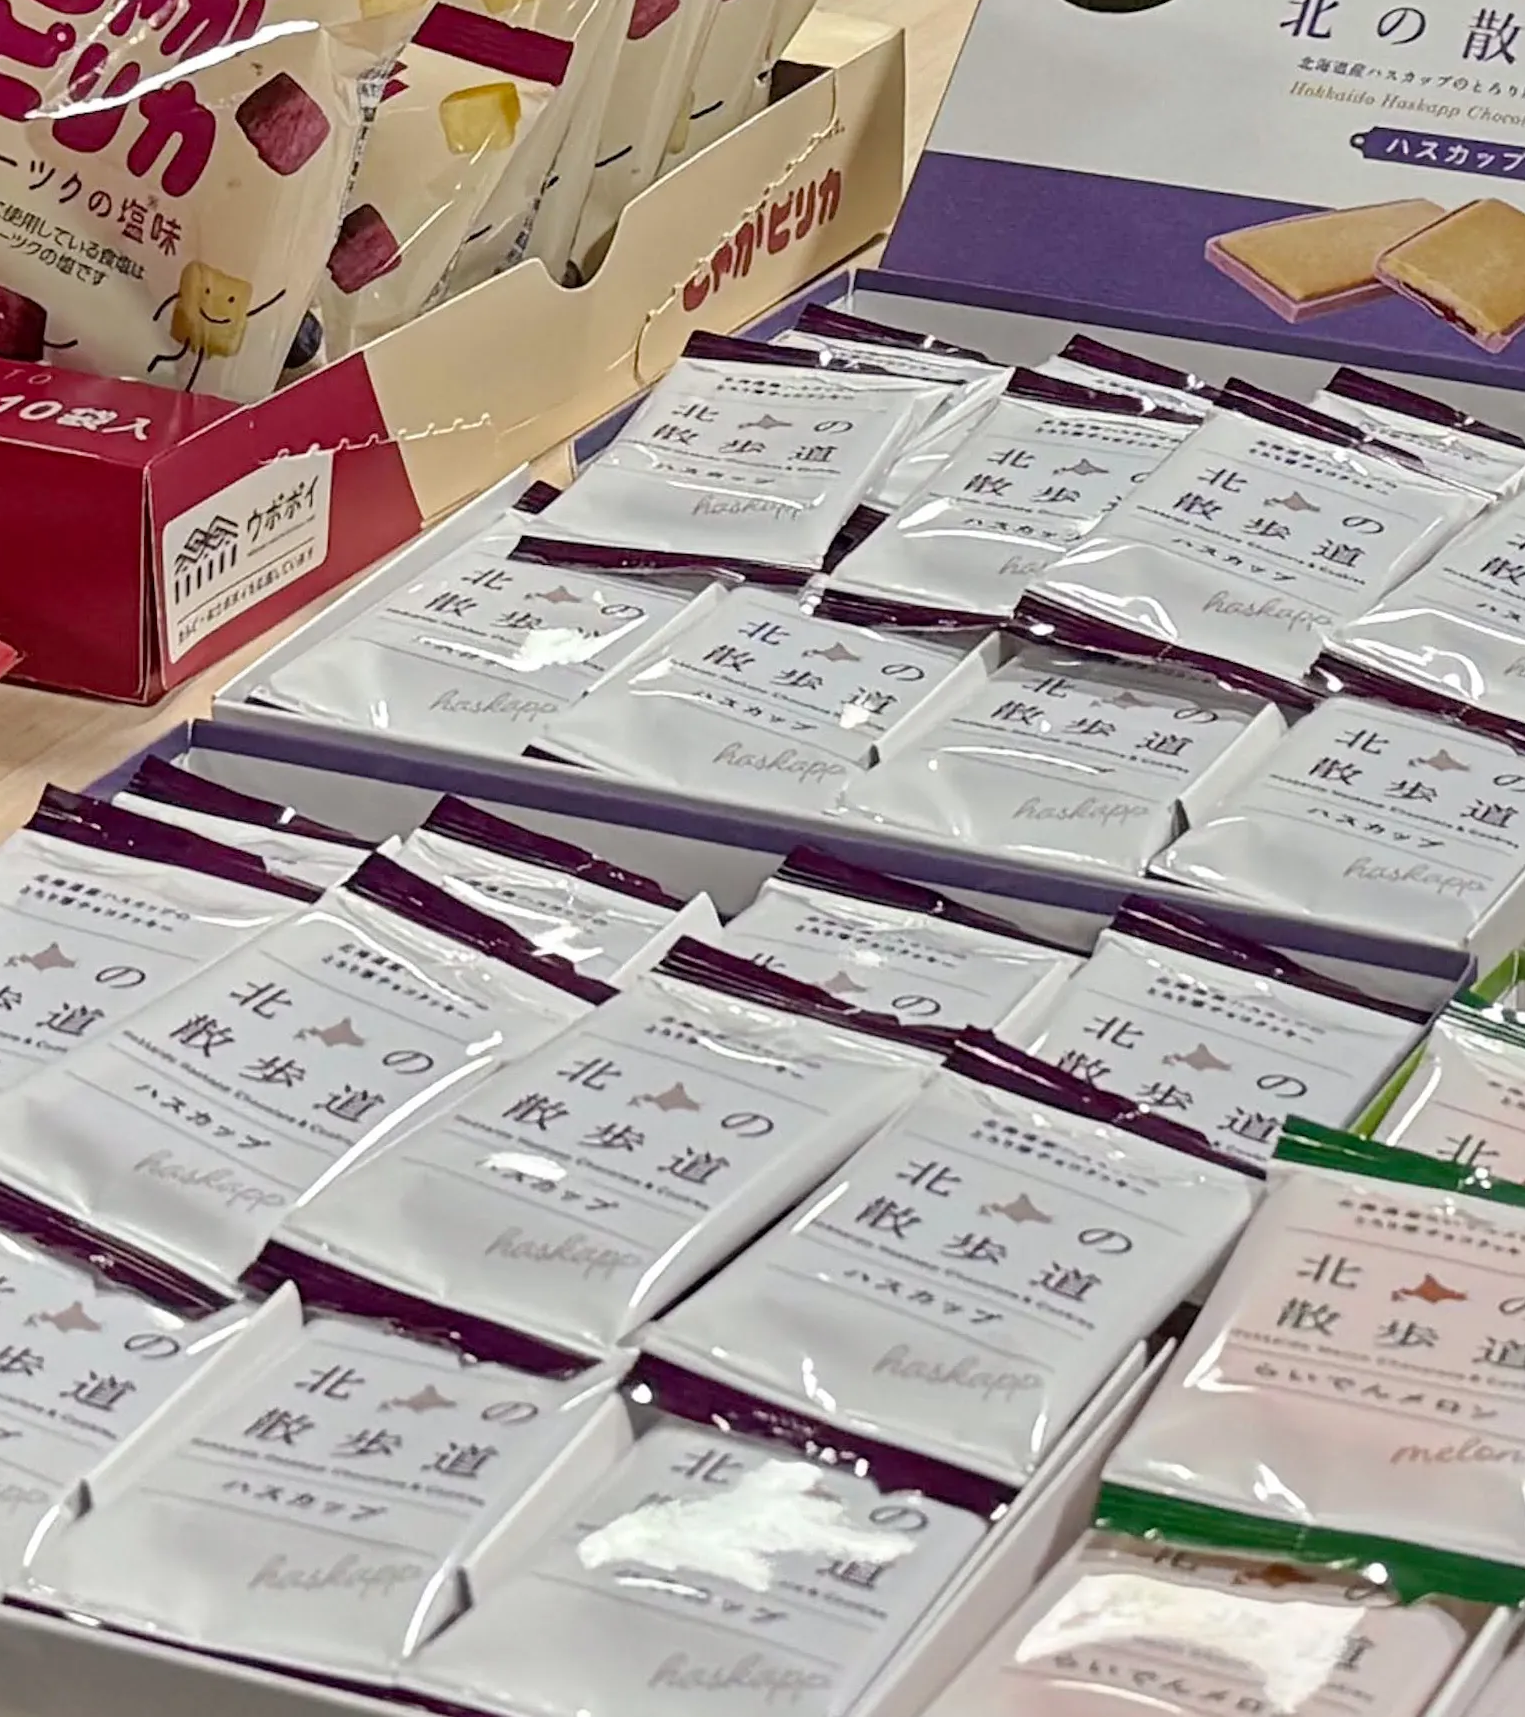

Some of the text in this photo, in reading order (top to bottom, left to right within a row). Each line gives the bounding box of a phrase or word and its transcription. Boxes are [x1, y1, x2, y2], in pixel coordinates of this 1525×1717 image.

[1288, 81, 1376, 106] Hokkaido
[1380, 94, 1462, 121] Haskapp
[651, 422, 839, 466] 散歩道
[1172, 492, 1368, 570] 散歩道
[992, 699, 1194, 757] 散歩道
[1308, 755, 1519, 831] 散歩道
[168, 1013, 386, 1124] 散歩道
[134, 1083, 273, 1150] ハスカップ
[499, 1089, 732, 1187] 散歩道
[134, 1149, 286, 1213] haskapp
[854, 1194, 1104, 1304] 散歩道
[843, 1266, 1005, 1326] ハスカップ
[1254, 1361, 1499, 1420] らいでんメロン
[242, 1405, 491, 1480] 散歩道
[220, 1478, 387, 1524] ハスカップ
